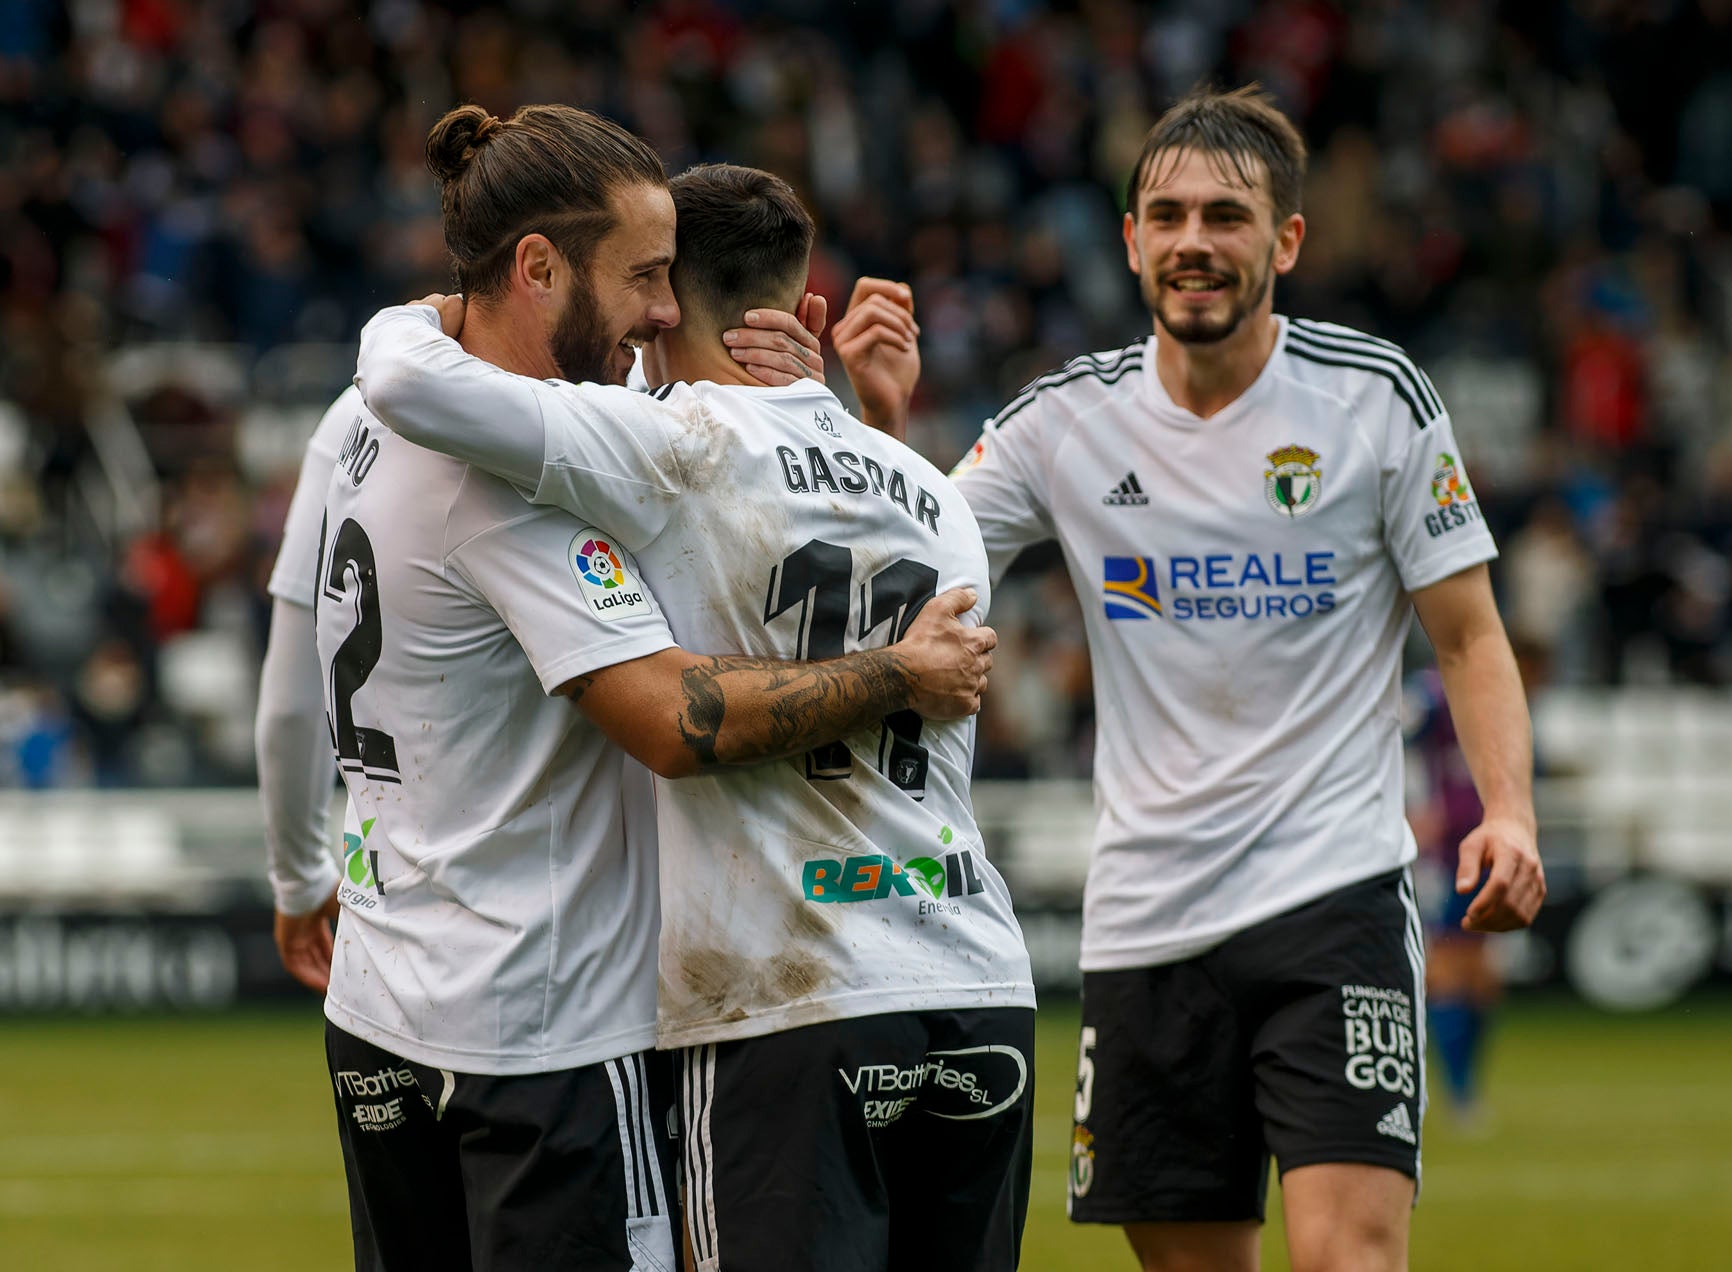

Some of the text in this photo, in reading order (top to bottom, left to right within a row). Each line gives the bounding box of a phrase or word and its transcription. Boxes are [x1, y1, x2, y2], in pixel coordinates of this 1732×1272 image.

[775, 445, 941, 536] GASPAR
[1169, 552, 1336, 589] REALE
[593, 591, 643, 611] LaLiga
[1173, 592, 1336, 620] SEGUROS
[1343, 999, 1412, 1027] CAJA DE
[1344, 1018, 1415, 1062] BUR
[1074, 1026, 1097, 1123] 5
[1344, 1054, 1416, 1099] GOS
[352, 1098, 403, 1123] EXIDE
[969, 1088, 993, 1106] SL
